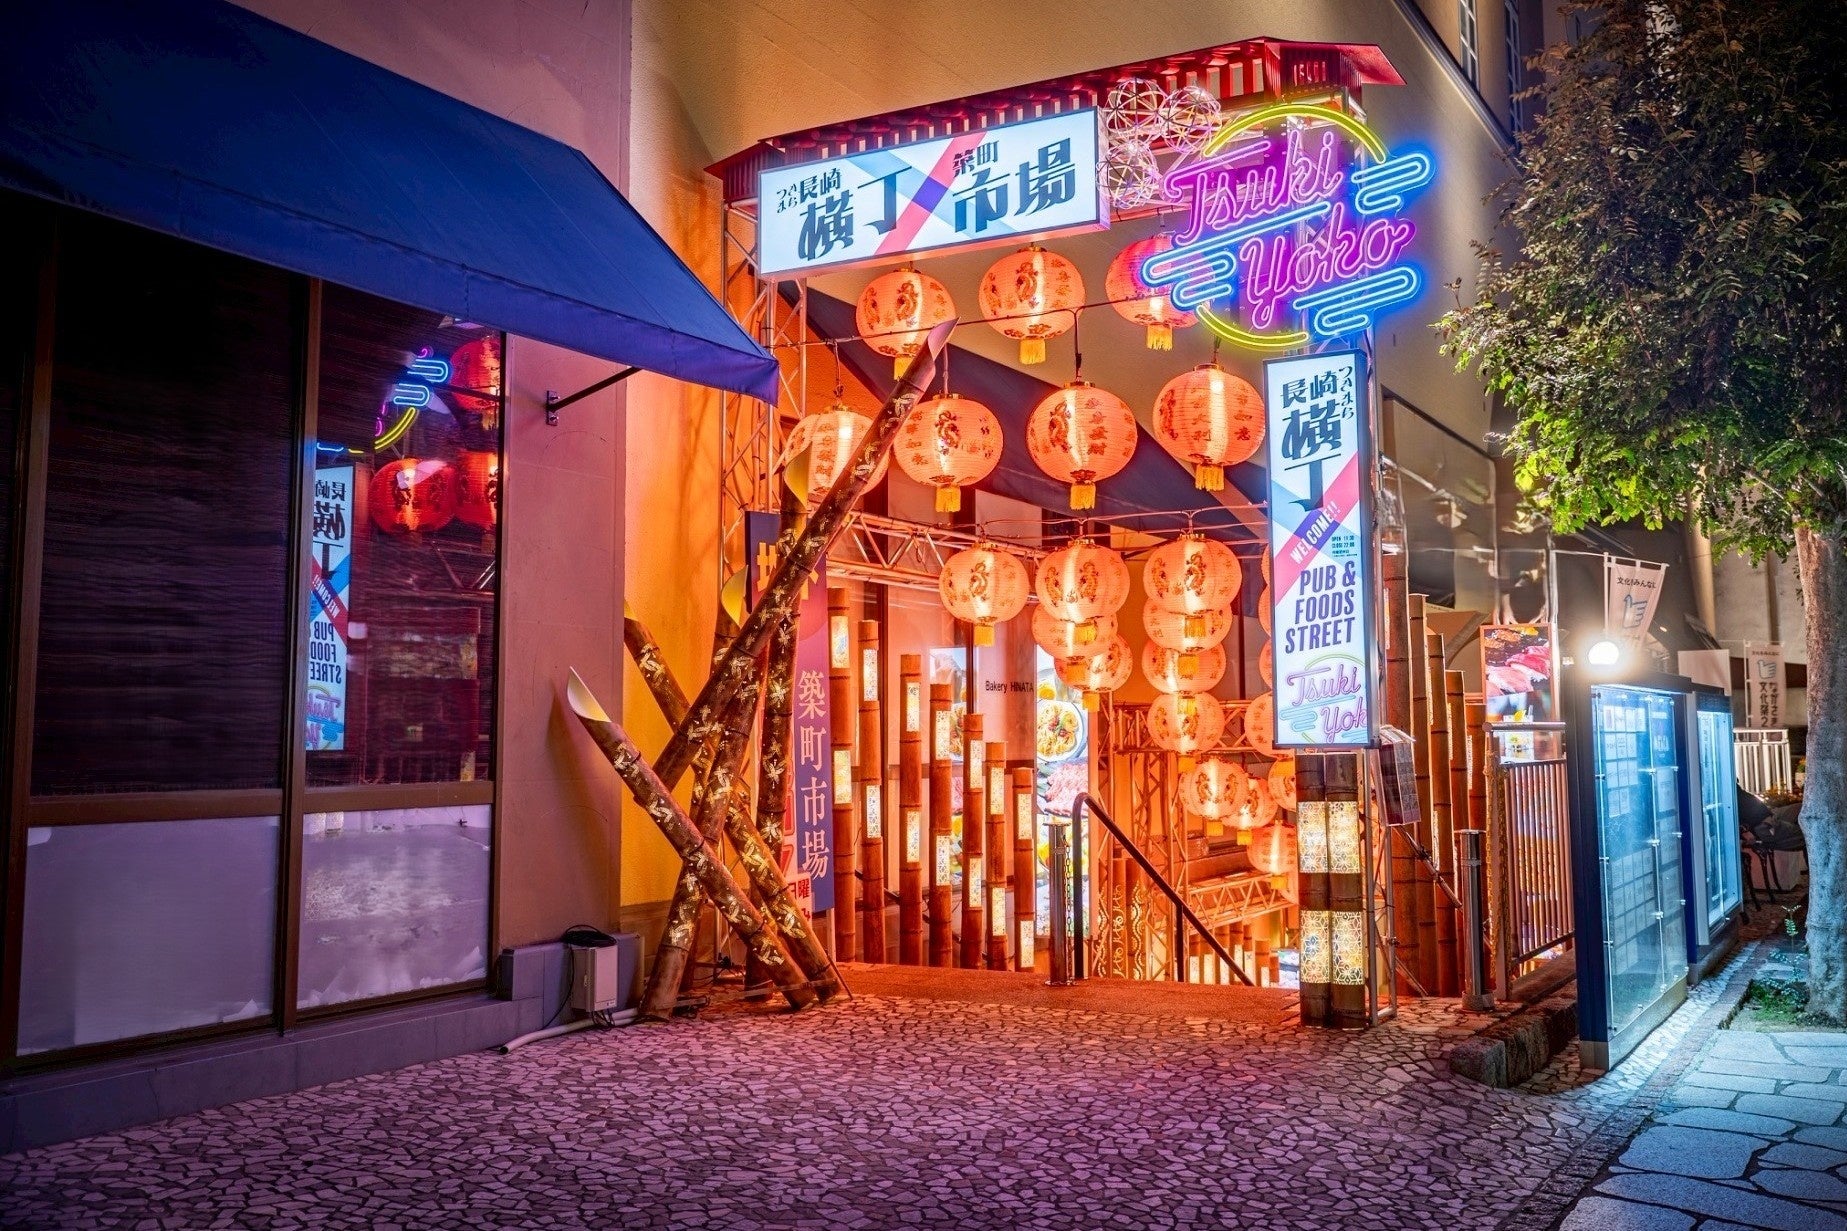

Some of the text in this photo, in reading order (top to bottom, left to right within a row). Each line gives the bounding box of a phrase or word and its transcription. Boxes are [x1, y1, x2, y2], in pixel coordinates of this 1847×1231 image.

[951, 140, 1000, 178] 築町
[799, 167, 842, 204] 長崎
[952, 137, 1076, 235] 市場
[1164, 130, 1343, 247] Tsuki
[797, 165, 913, 262] 横丁
[1239, 202, 1416, 330] Yoko
[1280, 370, 1339, 409] 長崎
[1290, 501, 1342, 564] WELCOME!!
[1299, 560, 1356, 595] PUB &
[1295, 589, 1355, 624] FOODS
[1285, 617, 1356, 654] STREET
[985, 680, 1034, 694] Bakery HINATA
[1287, 664, 1361, 707] Tsuki
[798, 670, 830, 881] 築町市場
